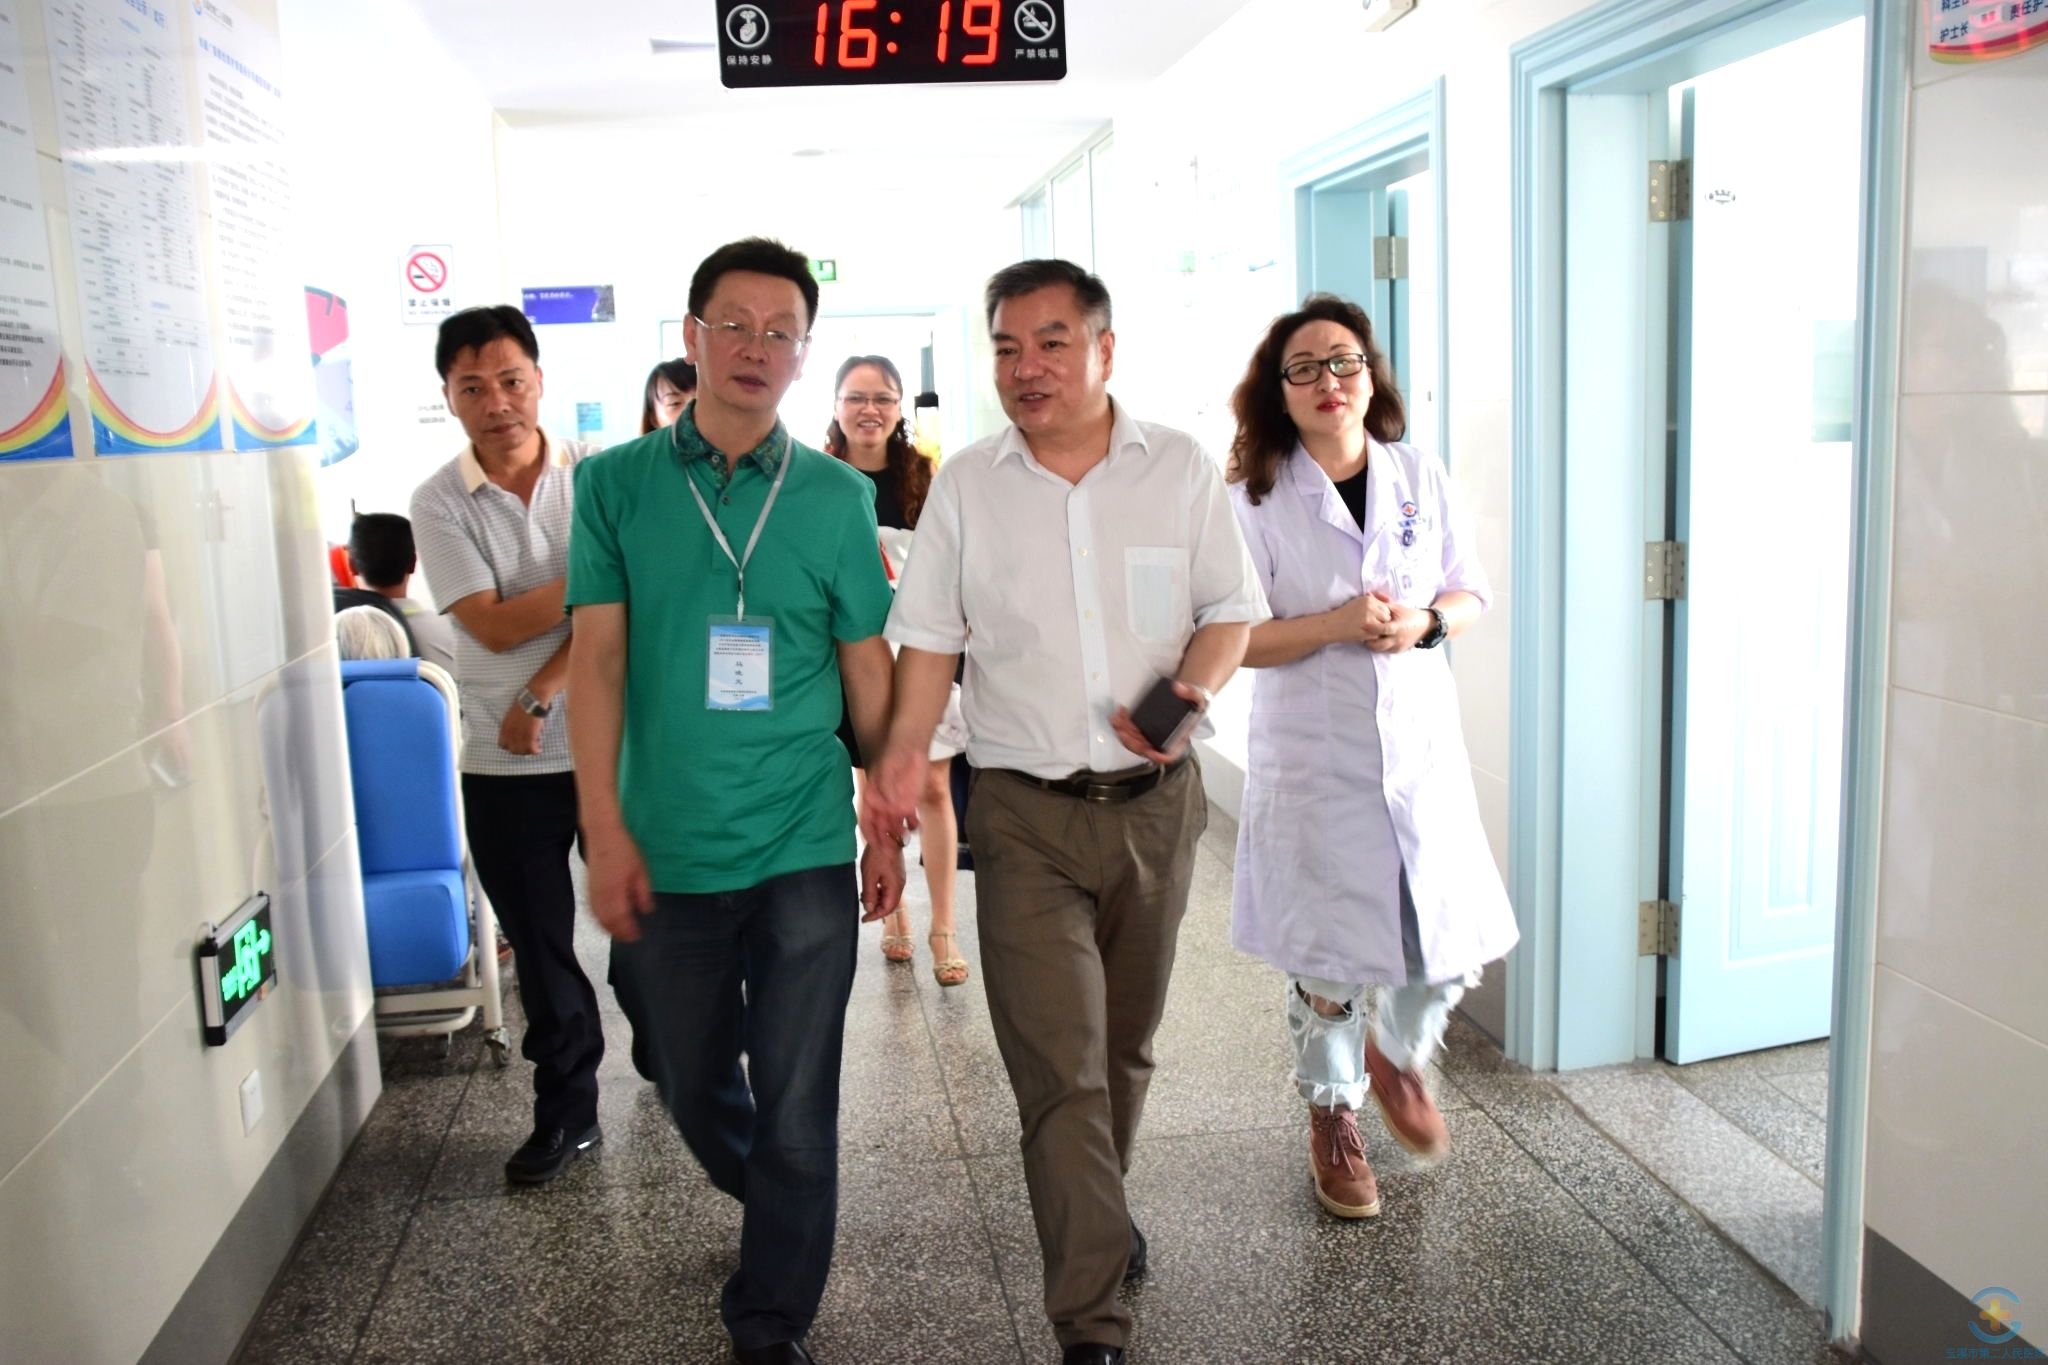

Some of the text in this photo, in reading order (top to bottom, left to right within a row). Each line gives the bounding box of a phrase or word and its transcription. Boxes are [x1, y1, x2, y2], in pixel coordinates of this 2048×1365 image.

[814, 0, 999, 67] 16:19
[1015, 48, 1059, 59] 严禁吸烟
[726, 54, 773, 66] 保持安静
